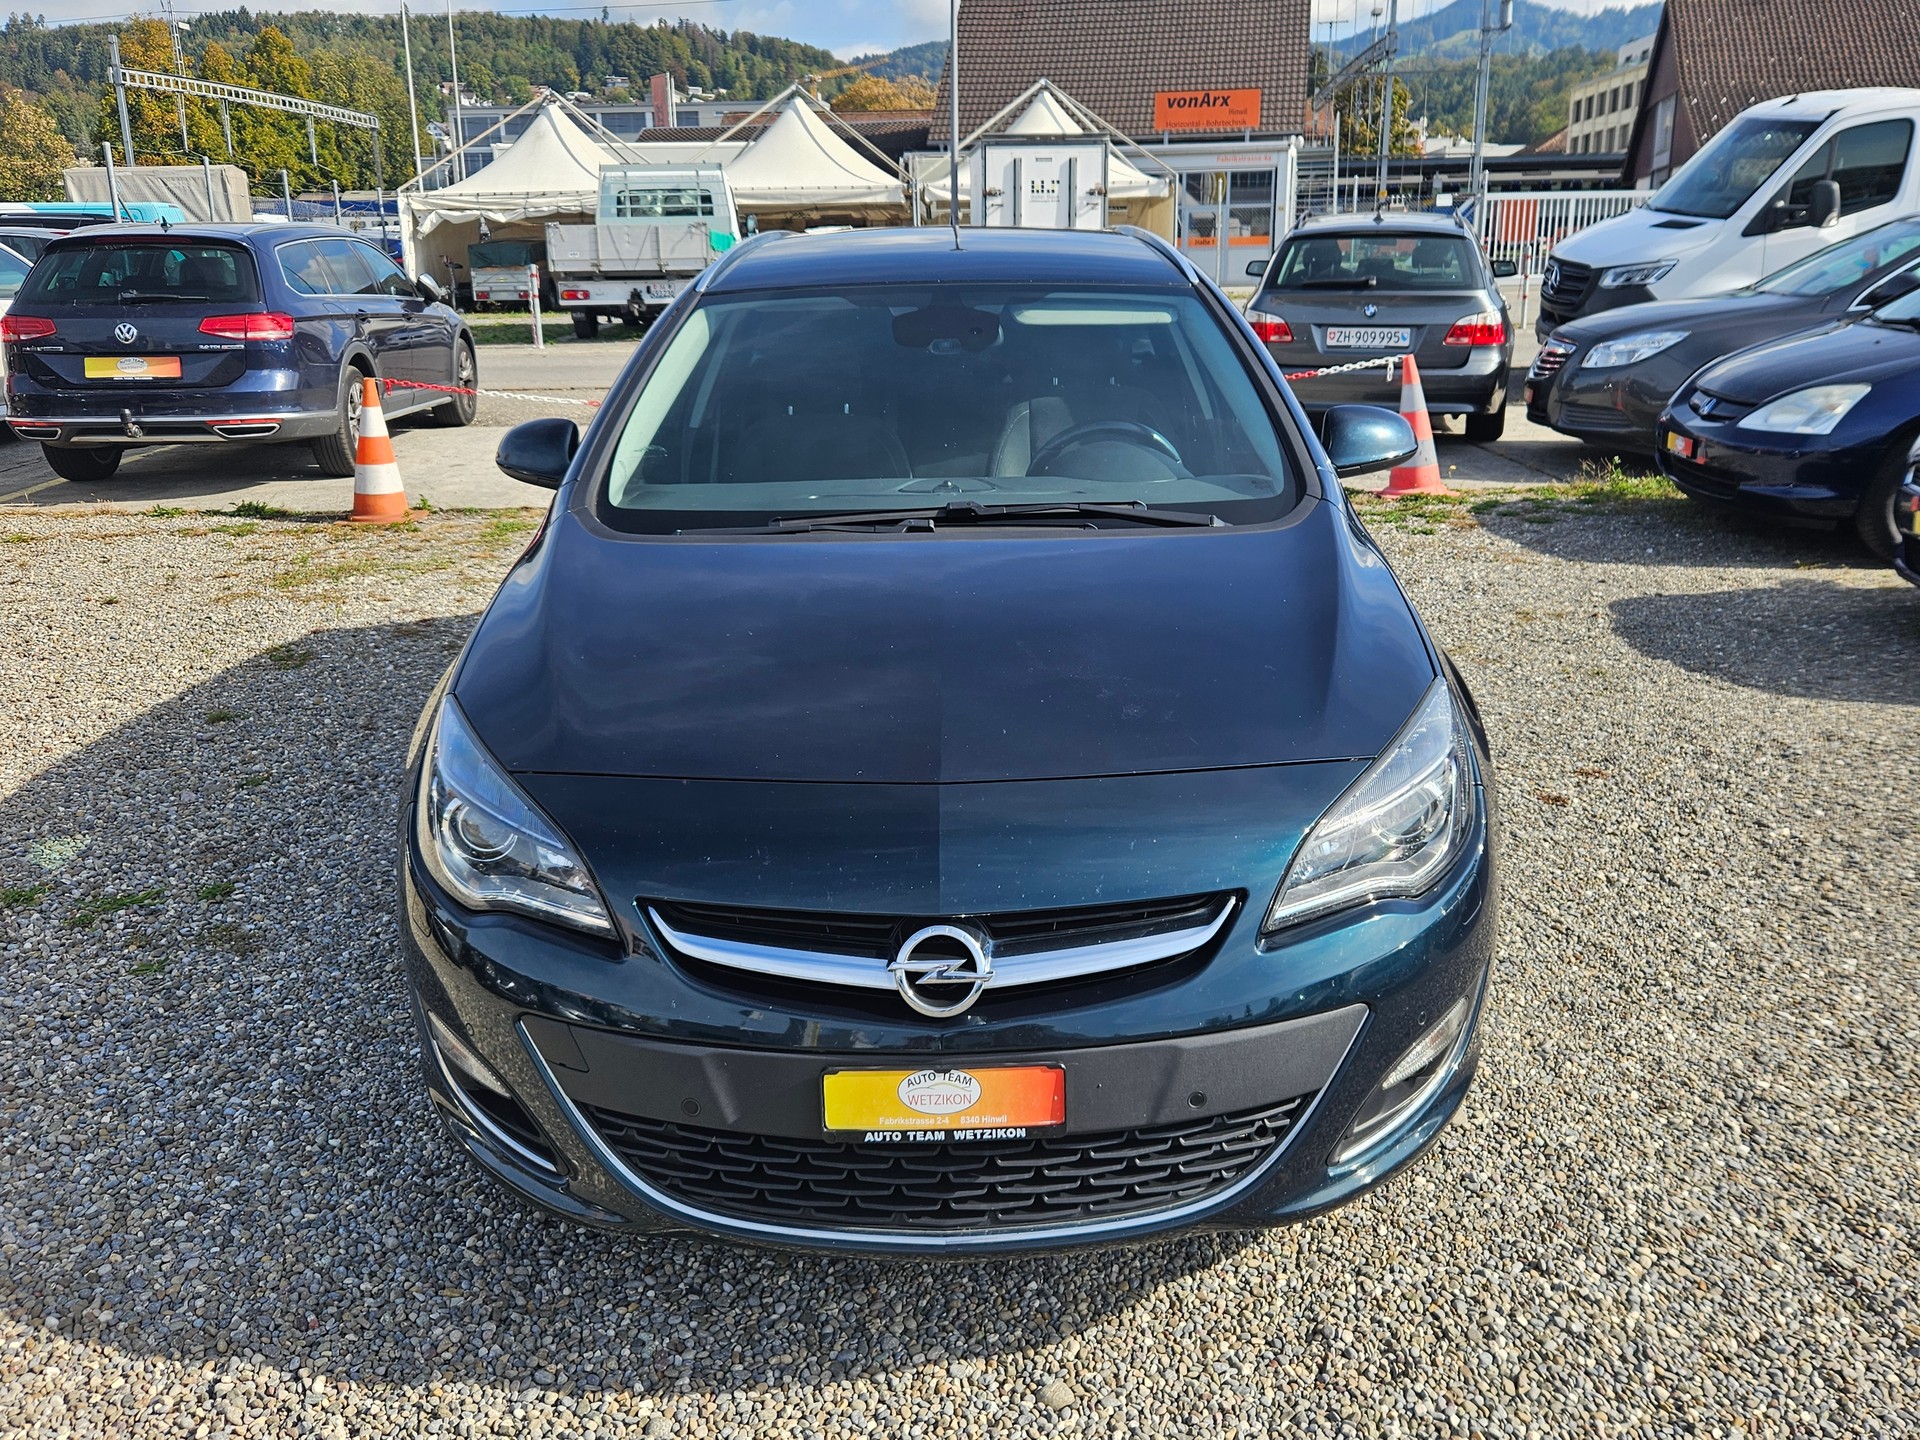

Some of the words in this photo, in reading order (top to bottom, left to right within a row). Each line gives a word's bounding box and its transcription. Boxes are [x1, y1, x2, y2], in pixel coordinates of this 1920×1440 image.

[1167, 92, 1231, 109] vonArx
[1228, 107, 1248, 115] Hinwil
[1165, 120, 1201, 128] Horizontal
[1205, 118, 1247, 127] Bohrtechnik
[906, 1071, 937, 1088] AUTO
[942, 1071, 972, 1087] TEAM
[907, 1093, 972, 1106] WETZIKON
[879, 1116, 935, 1125] Fabrikstrasse
[936, 1116, 949, 1124] 2-4
[960, 1115, 980, 1124] 8340
[981, 1114, 1007, 1123] Hinwil
[864, 1131, 902, 1142] AUTO
[906, 1130, 945, 1141] TEAM
[953, 1128, 1026, 1140] WETZIKON
